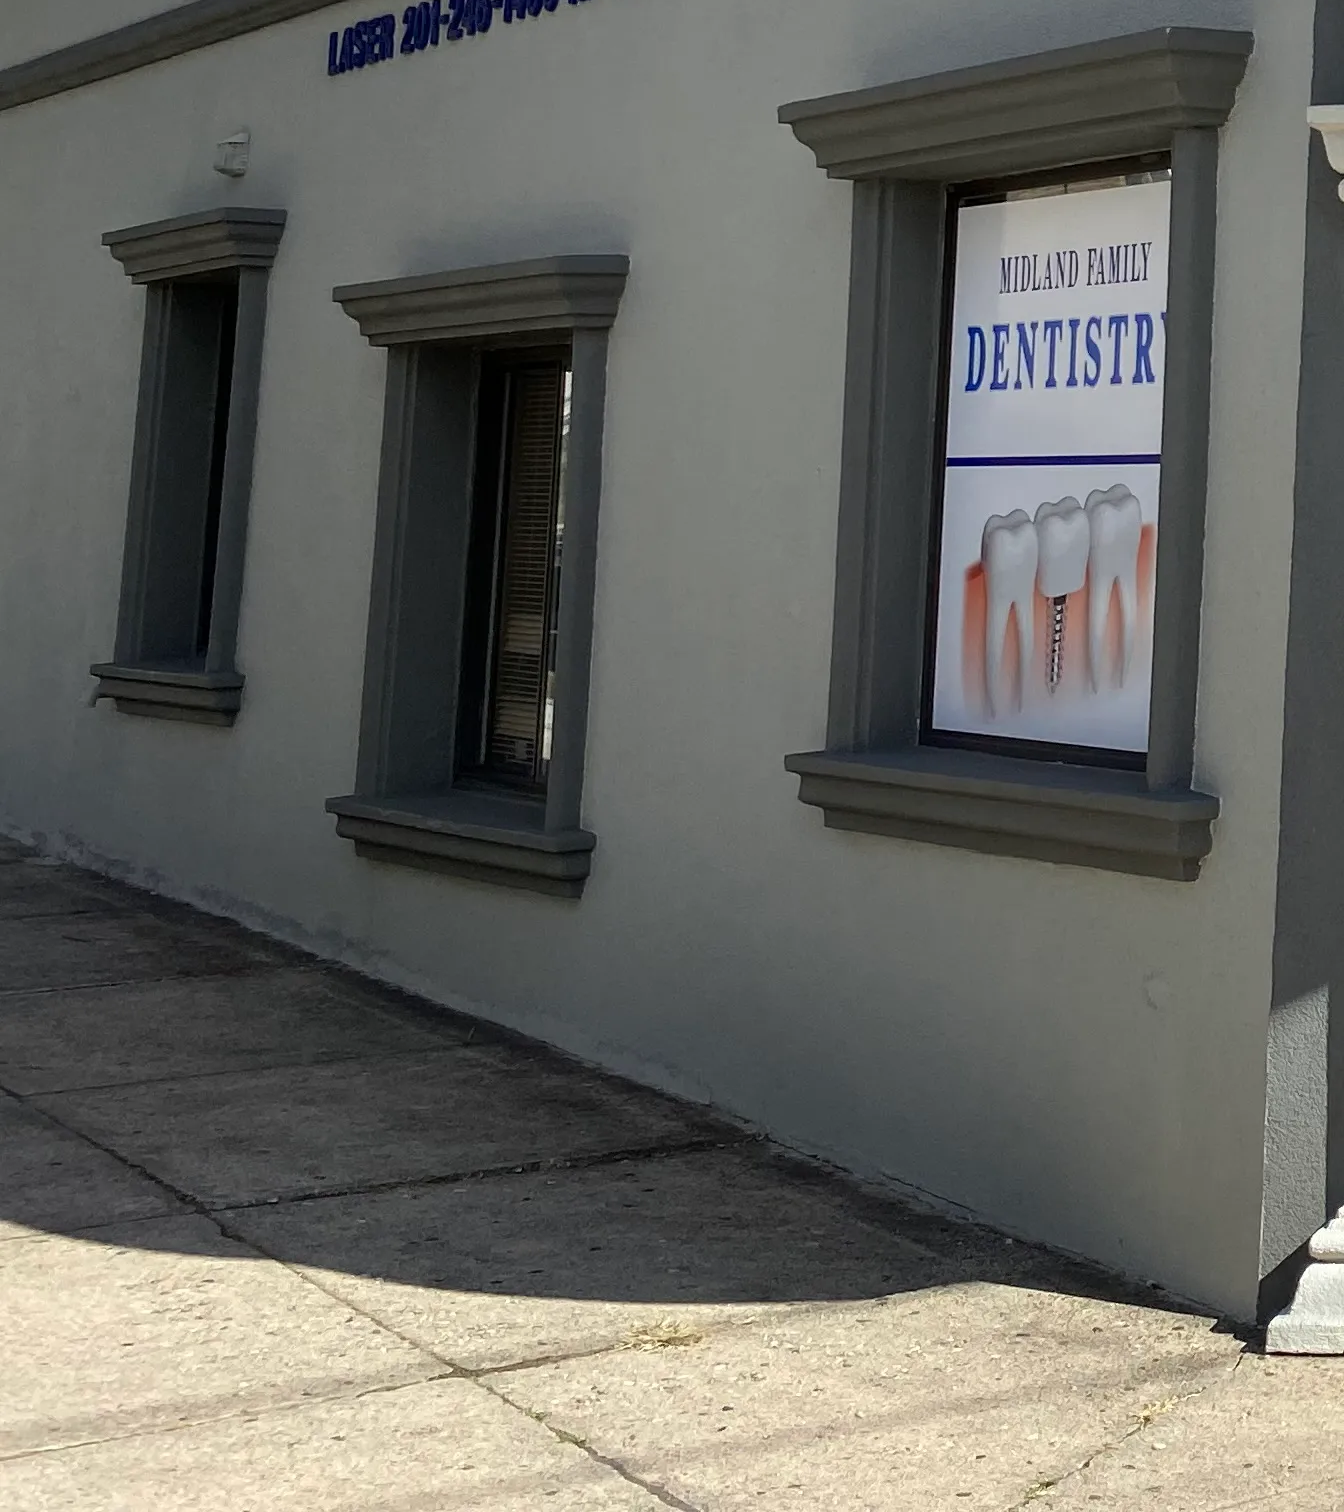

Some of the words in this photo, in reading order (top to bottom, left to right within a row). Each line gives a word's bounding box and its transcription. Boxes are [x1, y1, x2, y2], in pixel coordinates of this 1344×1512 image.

[327, 15, 396, 76] LASER
[999, 249, 1079, 294] MIDLAND
[1086, 242, 1152, 286] FAMILY
[965, 310, 1168, 392] DENTISTR
